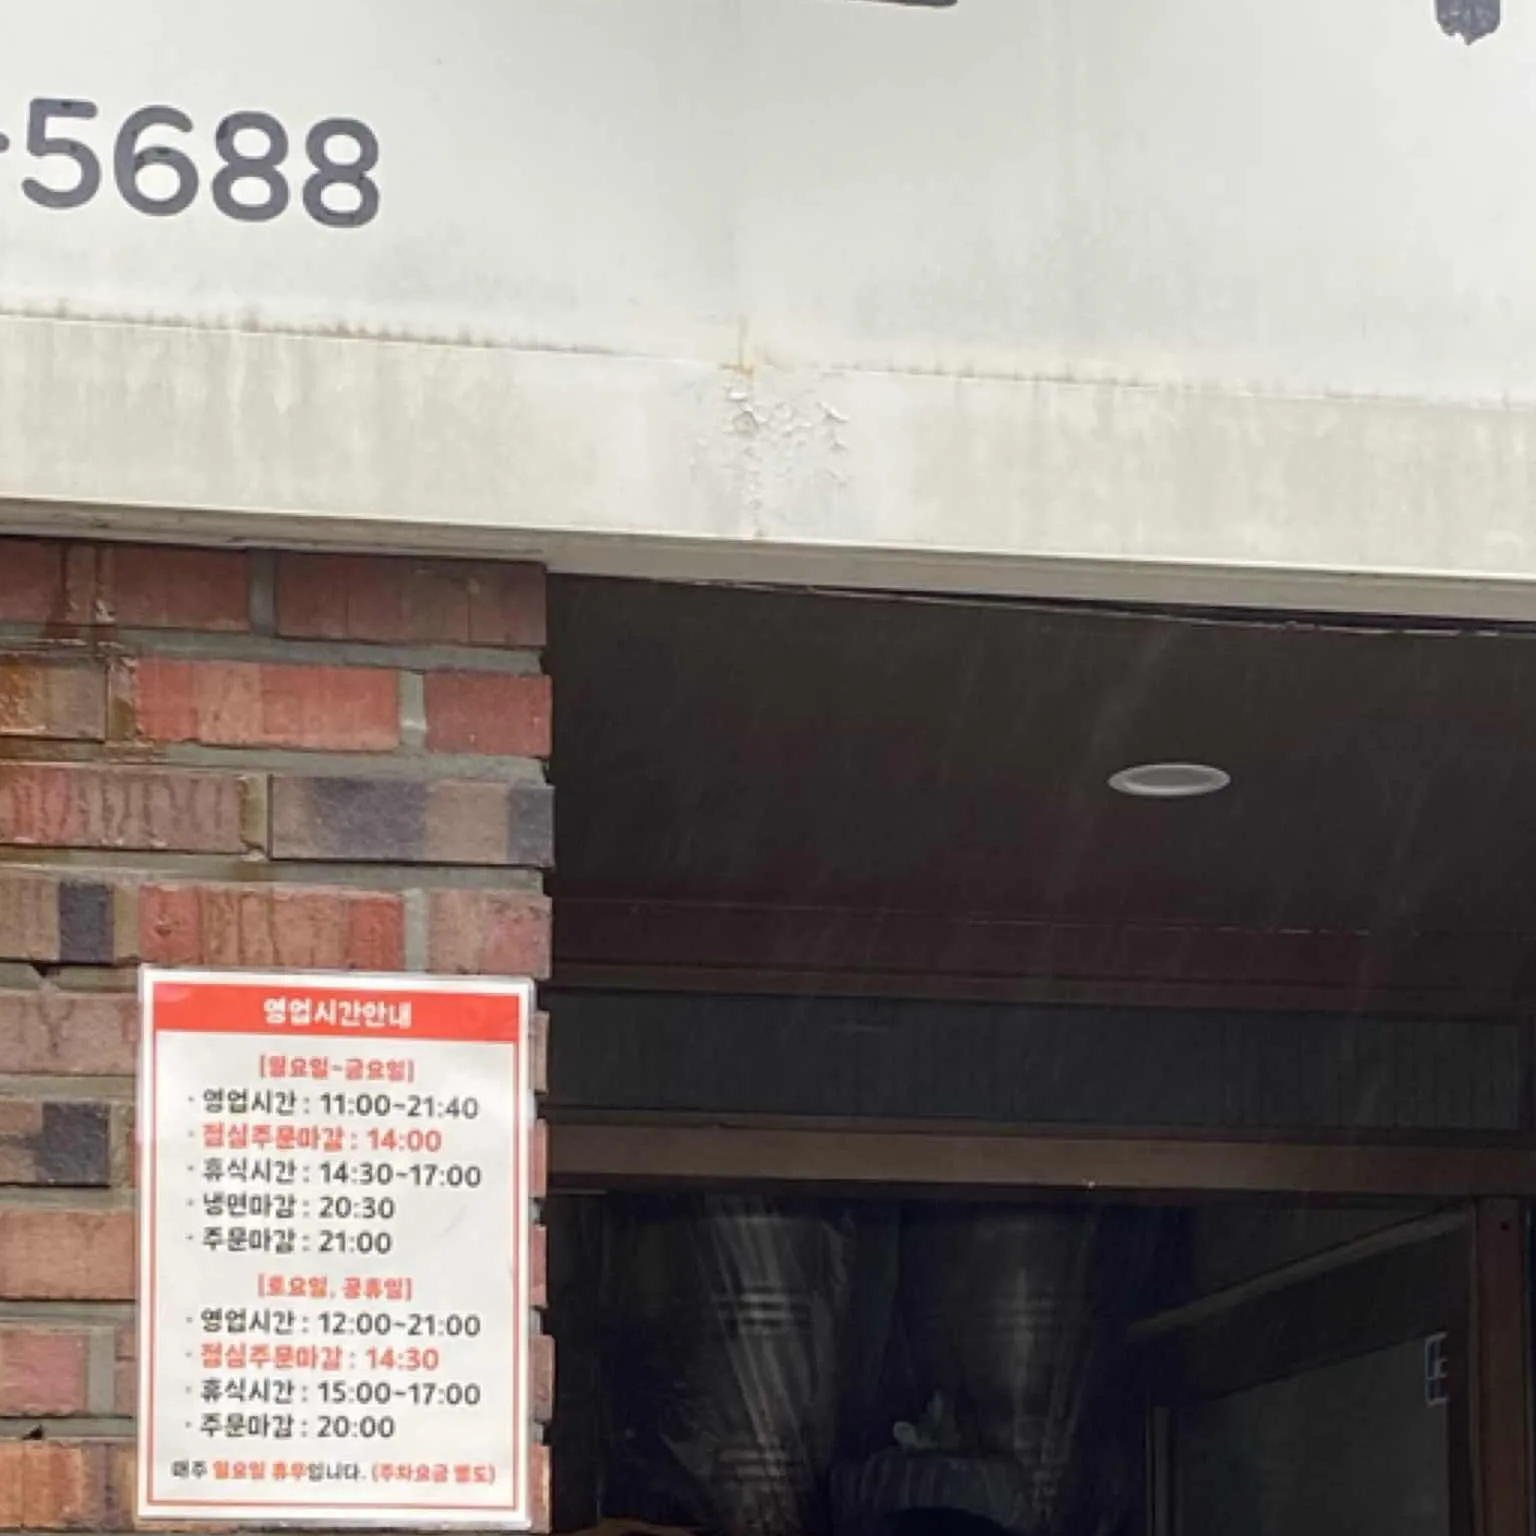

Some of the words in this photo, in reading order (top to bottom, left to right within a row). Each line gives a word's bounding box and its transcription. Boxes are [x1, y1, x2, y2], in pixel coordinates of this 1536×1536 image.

[263, 997, 413, 1029] 영업시간안내
[203, 1088, 297, 1116] 영업시간
[321, 1093, 480, 1120] 11:00~21:40
[368, 1128, 442, 1152] 14:00
[202, 1157, 296, 1185] 휴식시간
[320, 1163, 482, 1188] 14:30~17:00
[318, 1197, 396, 1219] 20:30
[201, 1226, 295, 1254] 주문마감
[318, 1231, 392, 1254] 21:00
[201, 1307, 295, 1335] 영업시간
[318, 1312, 482, 1337] 12:00~21:00
[366, 1348, 440, 1371] 14:30
[200, 1377, 295, 1405] 휴식시간
[317, 1382, 482, 1405] 15:00~17:00
[200, 1412, 294, 1439] 주문마감
[317, 1415, 395, 1439] 20:00
